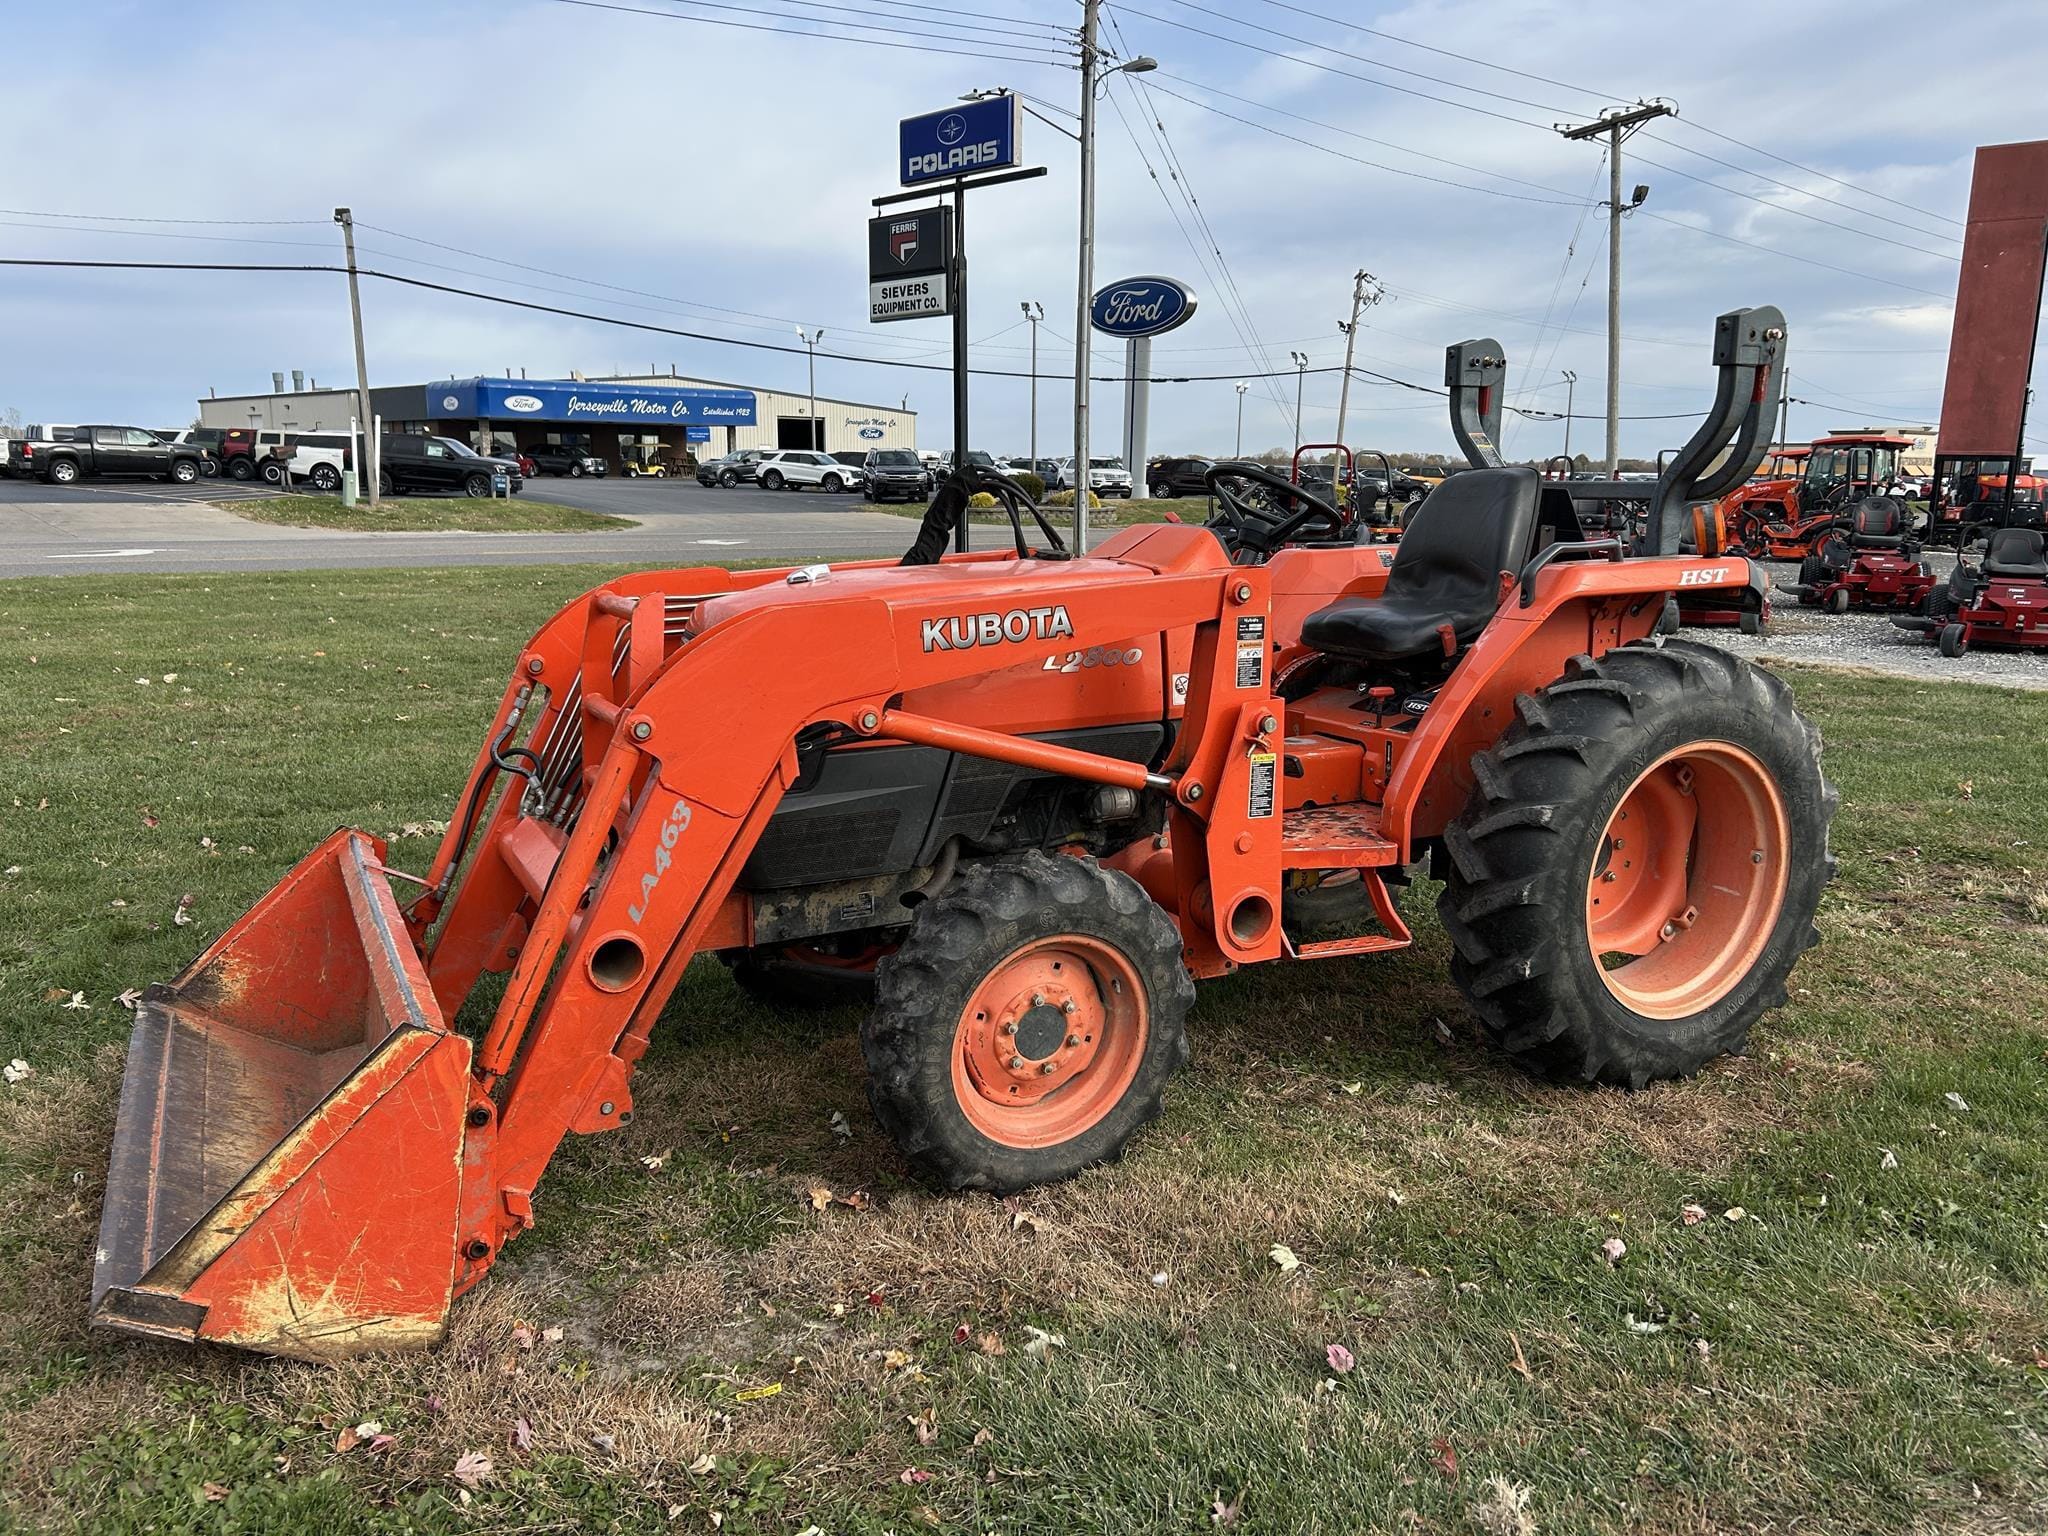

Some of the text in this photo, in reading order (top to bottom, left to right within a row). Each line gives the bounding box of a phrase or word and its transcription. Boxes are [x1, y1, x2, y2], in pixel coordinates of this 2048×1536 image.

[908, 140, 998, 176] POLARIS
[891, 222, 917, 235] FERRIS
[881, 282, 929, 299] SIEVERS
[872, 297, 940, 314] EQUIPMENT CO.
[1104, 288, 1165, 325] Ford
[512, 398, 535, 409] Ford
[567, 396, 690, 418] Jerseyville Motor Co.
[702, 406, 734, 416] Established
[863, 429, 880, 438] Ford
[1678, 567, 1729, 586] HST
[921, 604, 1074, 653] KUBOTA
[1041, 647, 1144, 673] L2800
[1406, 702, 1430, 711] HST
[627, 799, 693, 926] LA463
